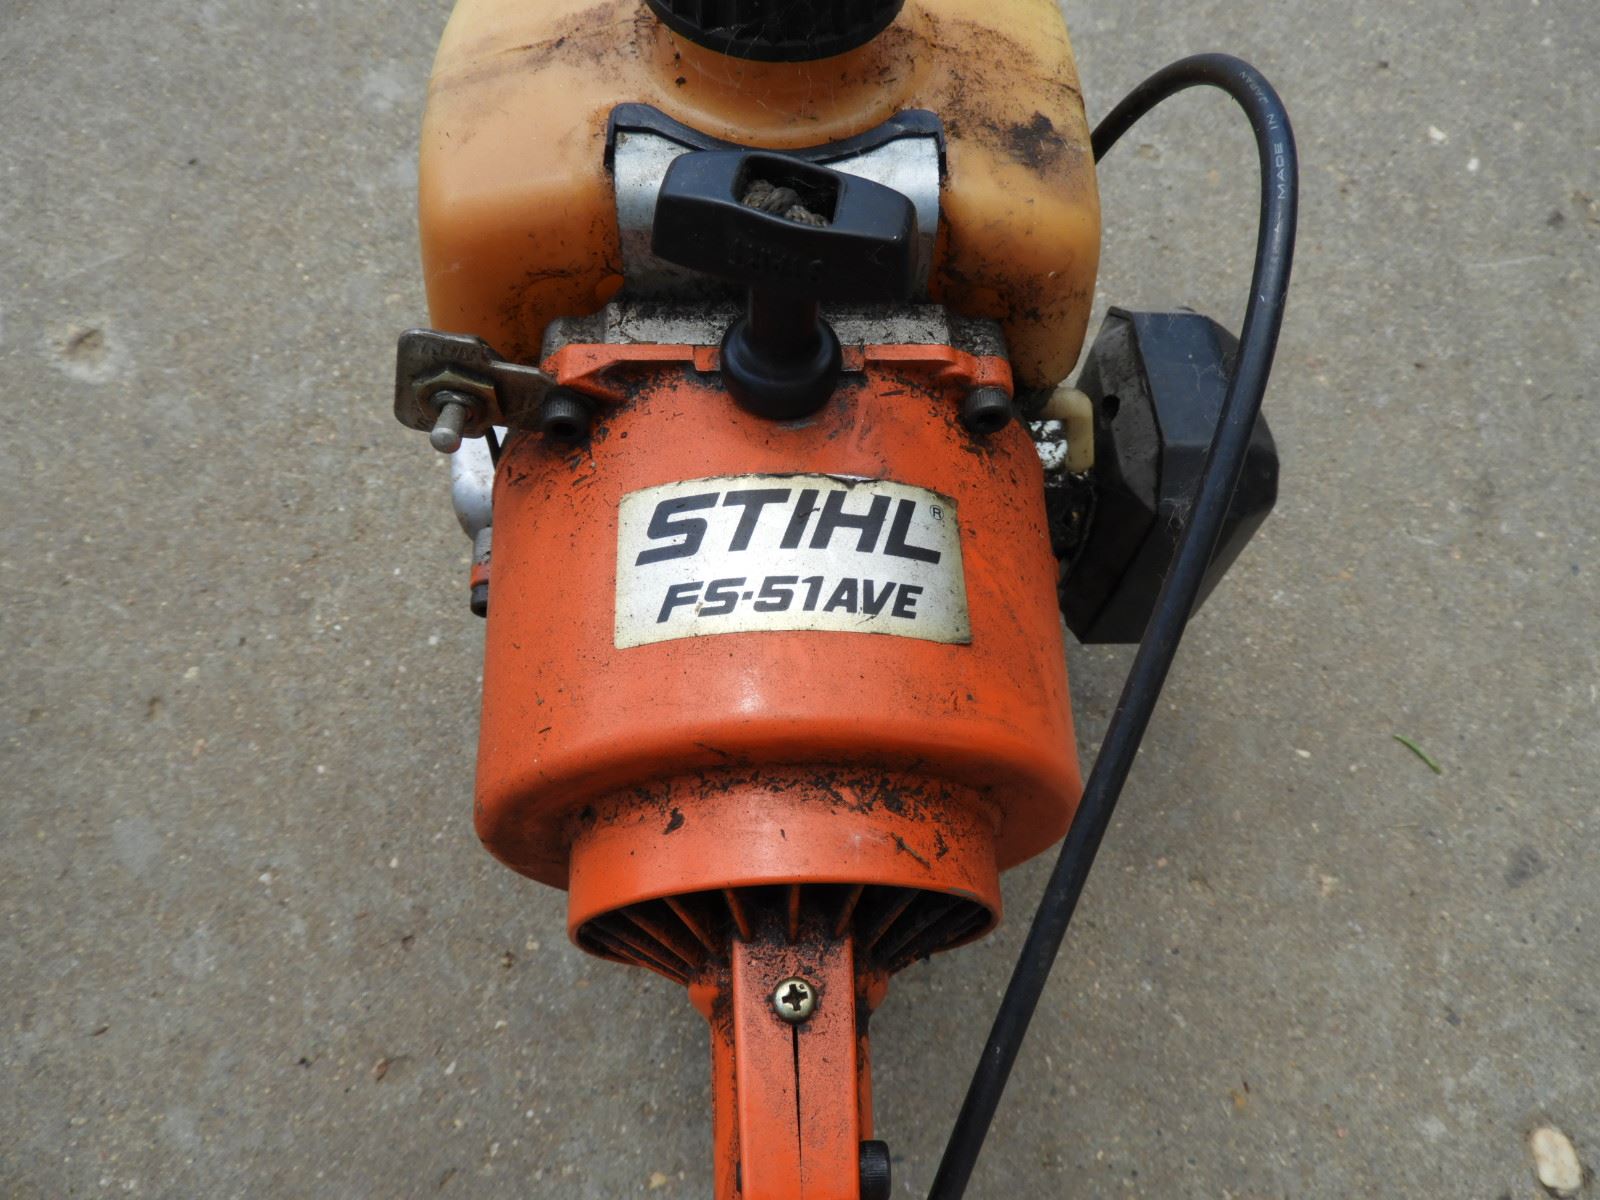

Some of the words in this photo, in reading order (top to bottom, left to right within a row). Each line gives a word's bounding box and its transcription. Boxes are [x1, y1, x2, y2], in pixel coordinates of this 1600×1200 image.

[1239, 71, 1269, 104] JAPAN
[1266, 113, 1280, 130] IN
[1273, 142, 1288, 199] MADE
[635, 488, 941, 566] STIHL
[656, 575, 924, 624] FS-51AVE
